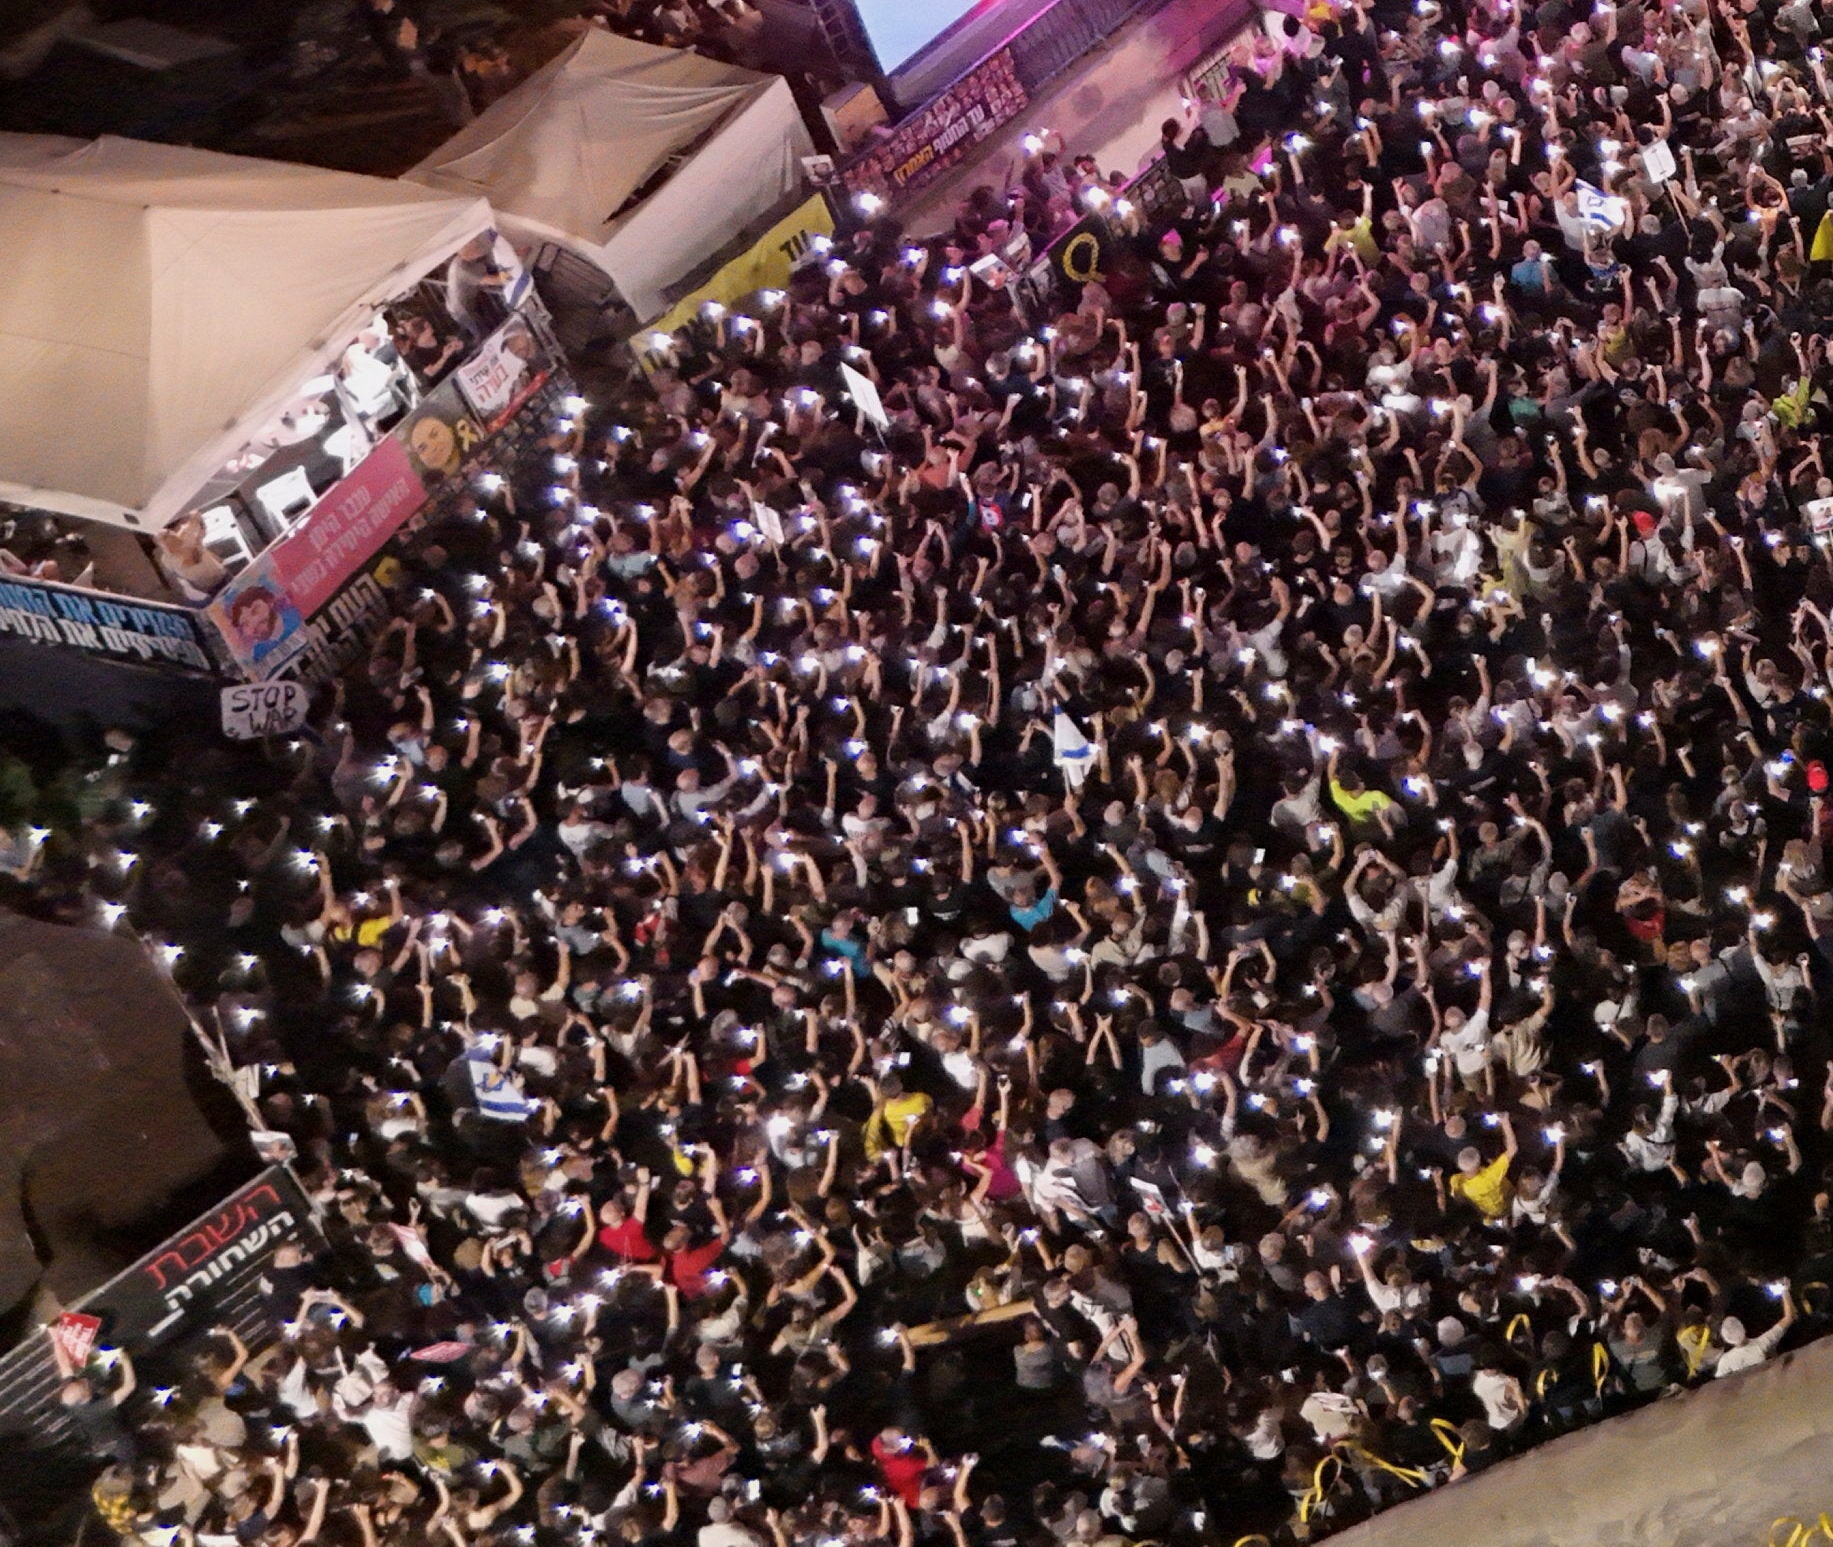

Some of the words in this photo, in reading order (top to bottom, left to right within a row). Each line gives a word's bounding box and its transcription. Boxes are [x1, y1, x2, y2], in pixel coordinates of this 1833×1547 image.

[931, 119, 972, 157] החטוף
[232, 685, 296, 713] STOP
[250, 707, 298, 734] WAR
[145, 1182, 281, 1291] השבת
[164, 1210, 295, 1311] השחורה
